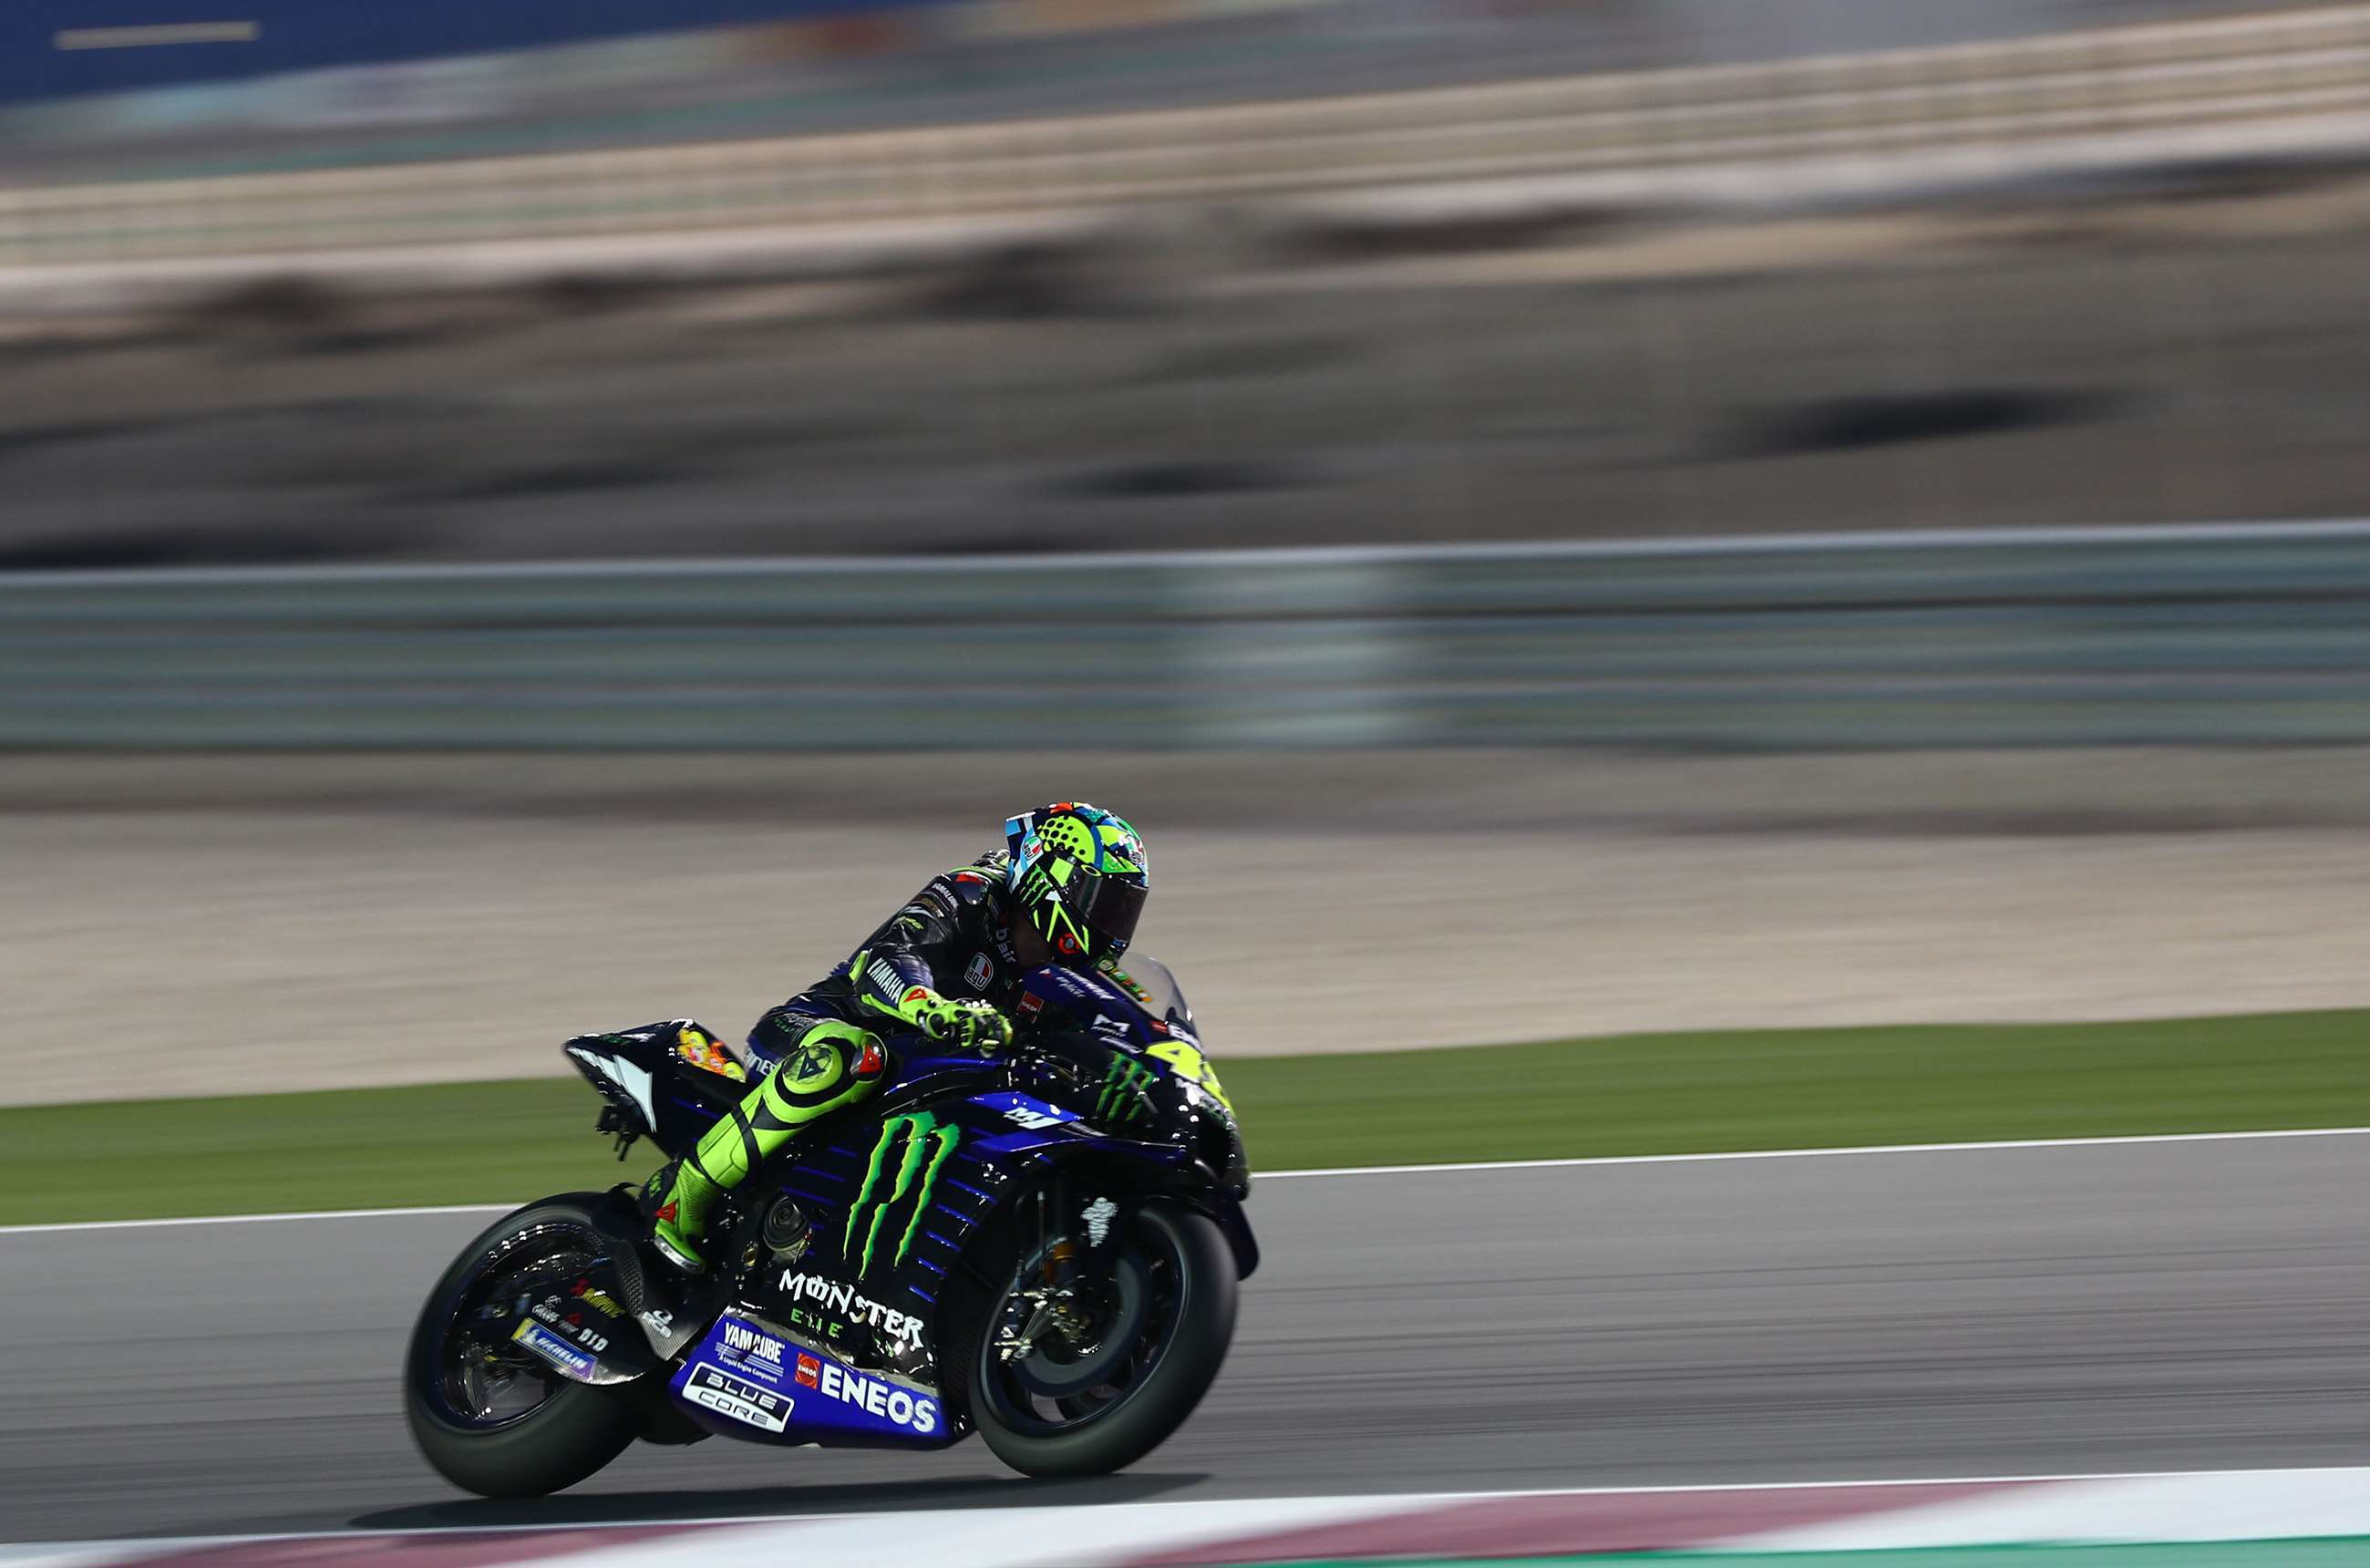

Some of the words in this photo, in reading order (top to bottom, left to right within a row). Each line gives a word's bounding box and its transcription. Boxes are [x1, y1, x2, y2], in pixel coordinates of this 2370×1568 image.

[867, 957, 906, 1005] YAMAHA
[778, 1268, 925, 1349] MONSTER
[536, 1336, 589, 1369] MICHELIN
[798, 1364, 818, 1377] ENEOS
[697, 1391, 768, 1427] CORE
[706, 1372, 778, 1410] BLUE
[821, 1363, 937, 1434] ENEOS
